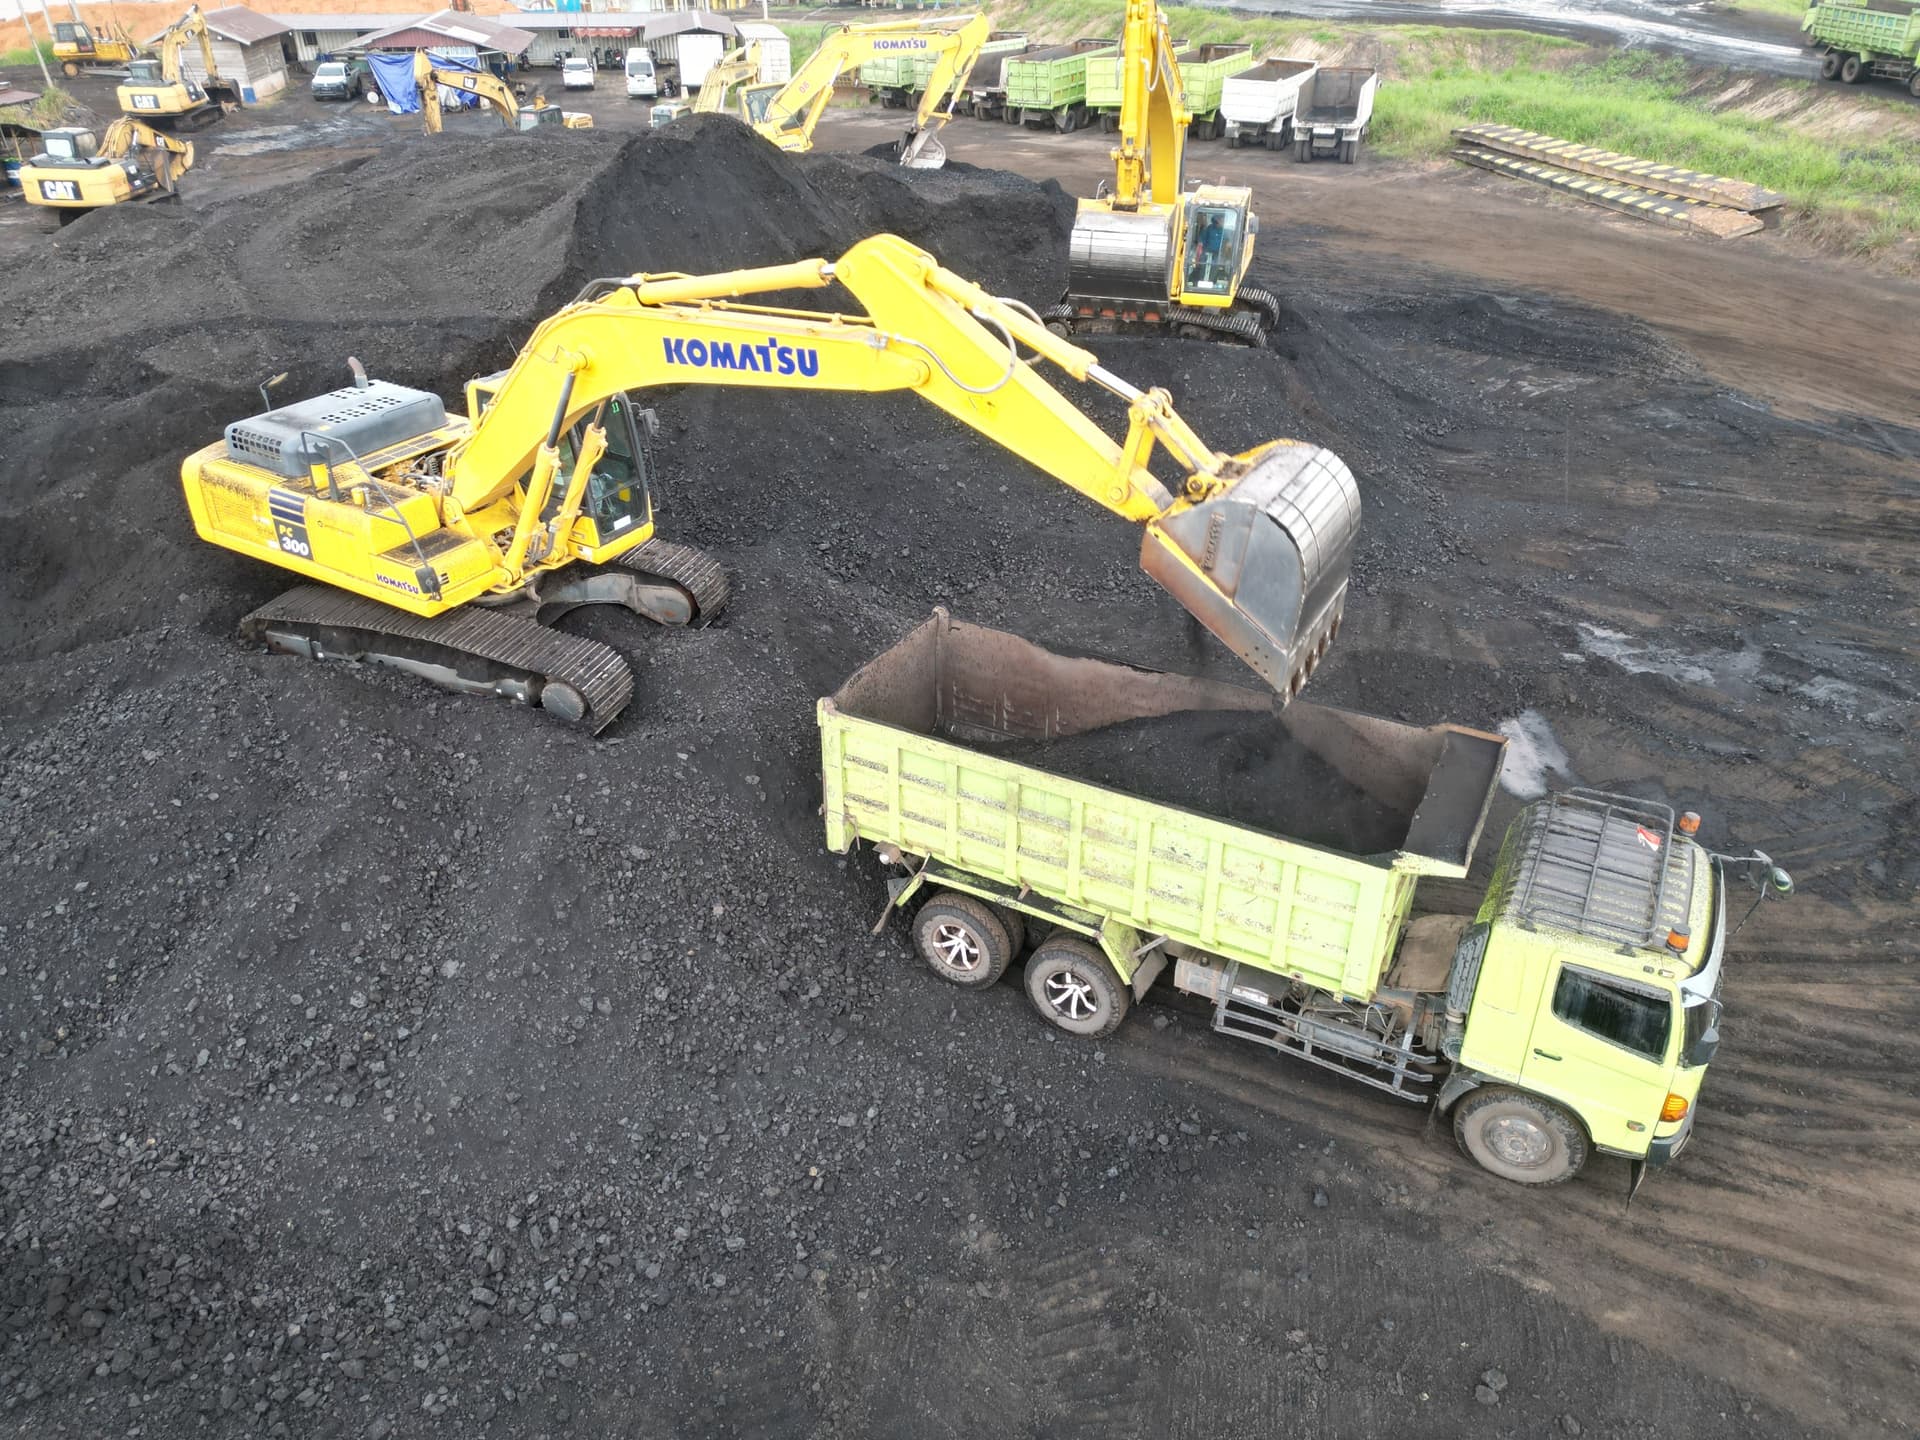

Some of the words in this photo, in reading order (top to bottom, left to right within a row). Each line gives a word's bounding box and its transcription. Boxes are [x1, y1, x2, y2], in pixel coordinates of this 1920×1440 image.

[873, 37, 927, 49] KOMATSU
[134, 95, 155, 109] CAT
[43, 180, 76, 200] CAT
[662, 337, 819, 378] KOMATSU
[279, 524, 293, 538] PC
[281, 536, 309, 556] 300
[376, 573, 419, 595] KOMATSU
